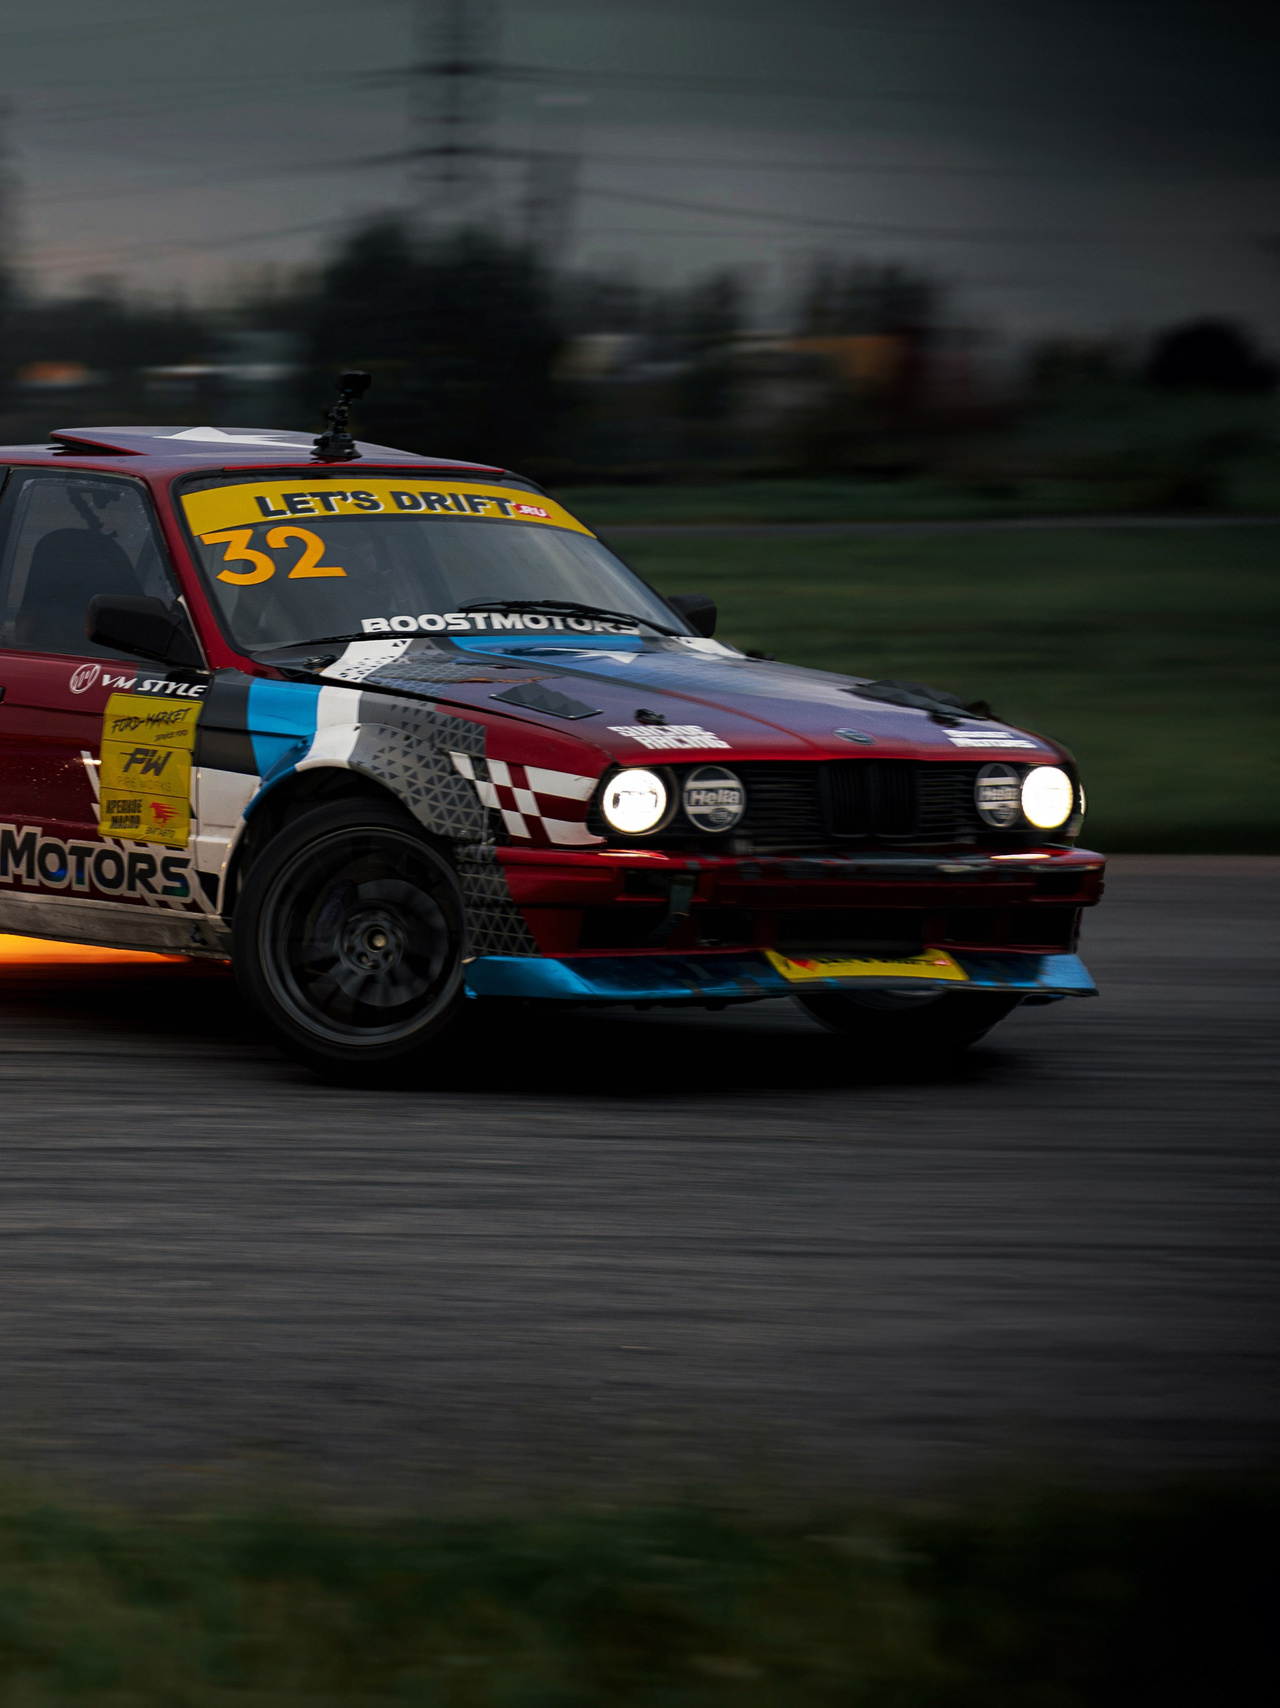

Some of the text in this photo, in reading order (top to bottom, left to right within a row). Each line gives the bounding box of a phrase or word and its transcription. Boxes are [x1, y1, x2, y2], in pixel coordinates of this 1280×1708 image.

[254, 490, 384, 518] LET'S
[200, 526, 348, 586] 32
[101, 674, 209, 697] VM STYLE
[631, 736, 734, 750] RACING
